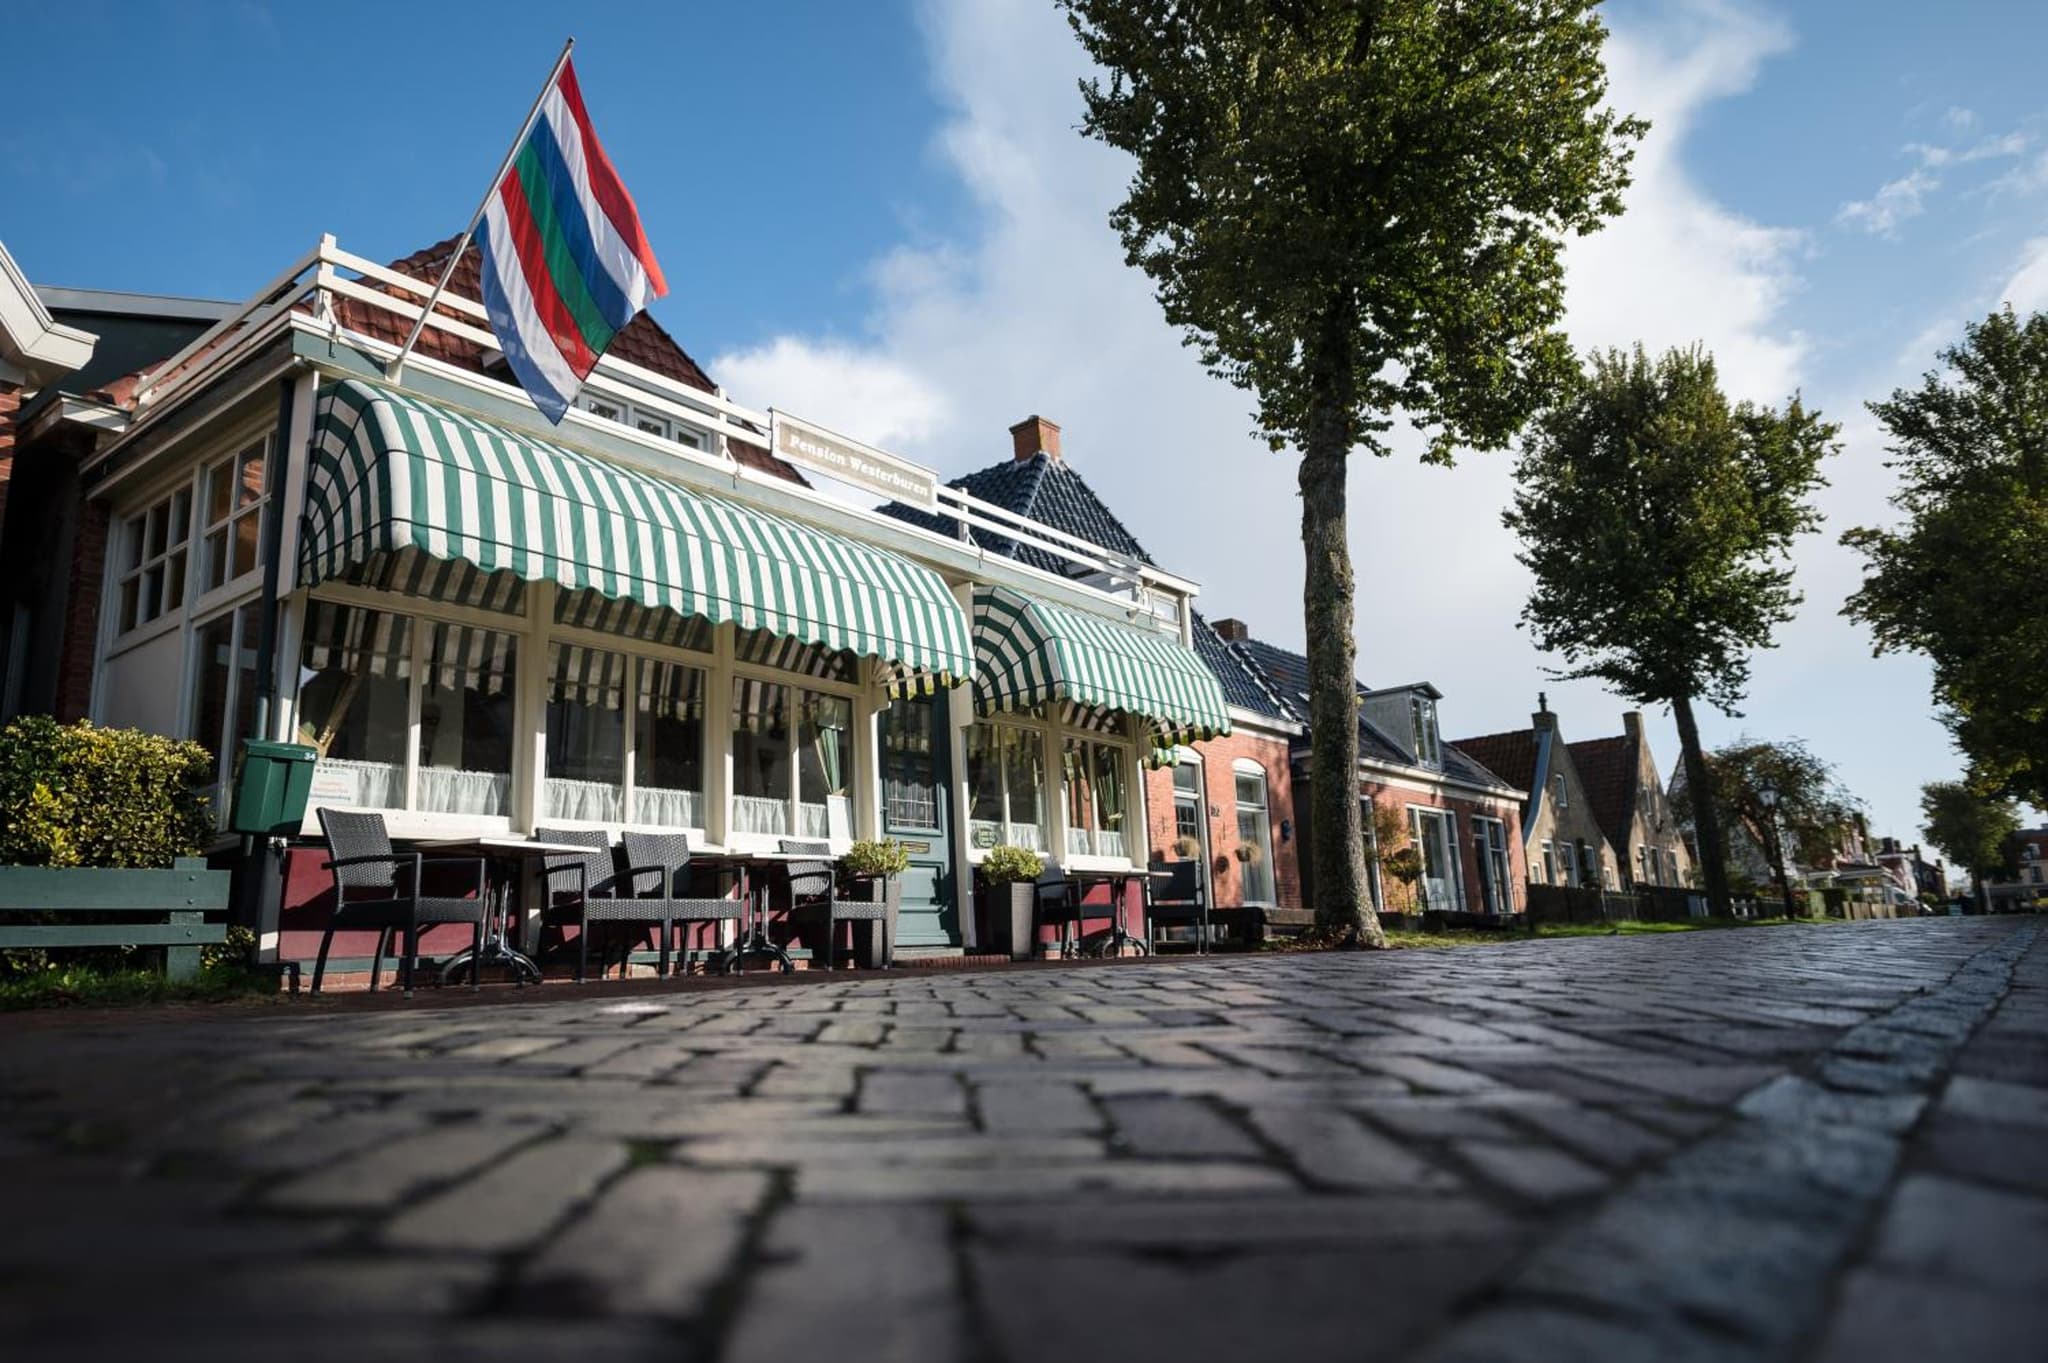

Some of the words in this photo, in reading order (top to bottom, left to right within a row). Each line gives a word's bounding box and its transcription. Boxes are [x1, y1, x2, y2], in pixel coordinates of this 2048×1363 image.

[790, 434, 846, 465] Pension
[850, 457, 929, 496] Westerburen
[304, 752, 316, 760] 34
